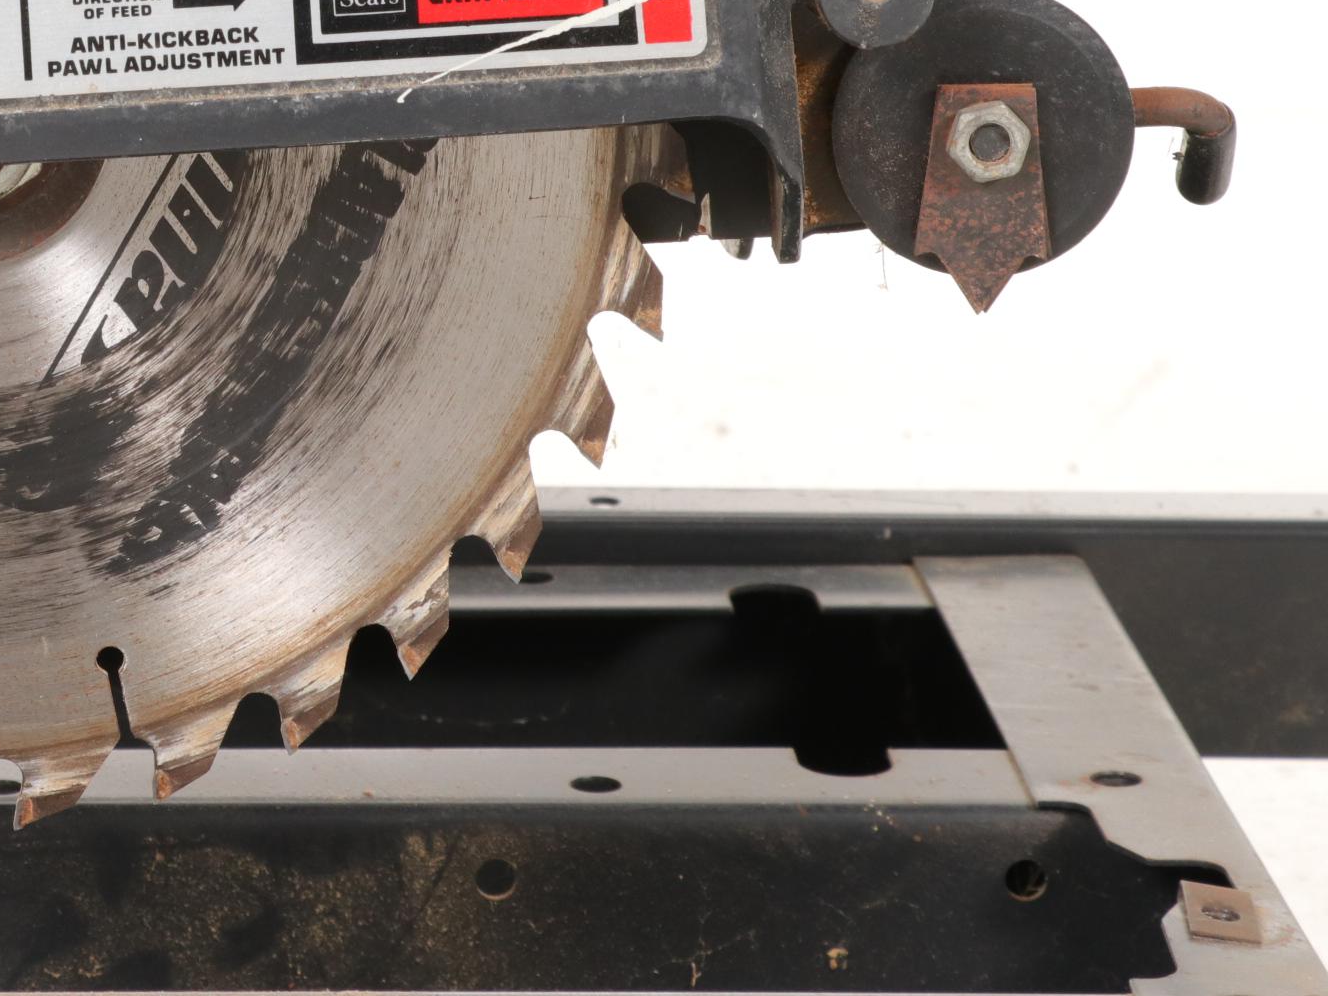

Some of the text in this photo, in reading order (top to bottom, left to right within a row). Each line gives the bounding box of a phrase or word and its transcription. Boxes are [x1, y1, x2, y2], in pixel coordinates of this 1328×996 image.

[83, 4, 152, 20] OF FEED
[70, 27, 260, 54] ANTI-KICKBACK
[47, 48, 285, 78] PAWL ADJUSTMENT
